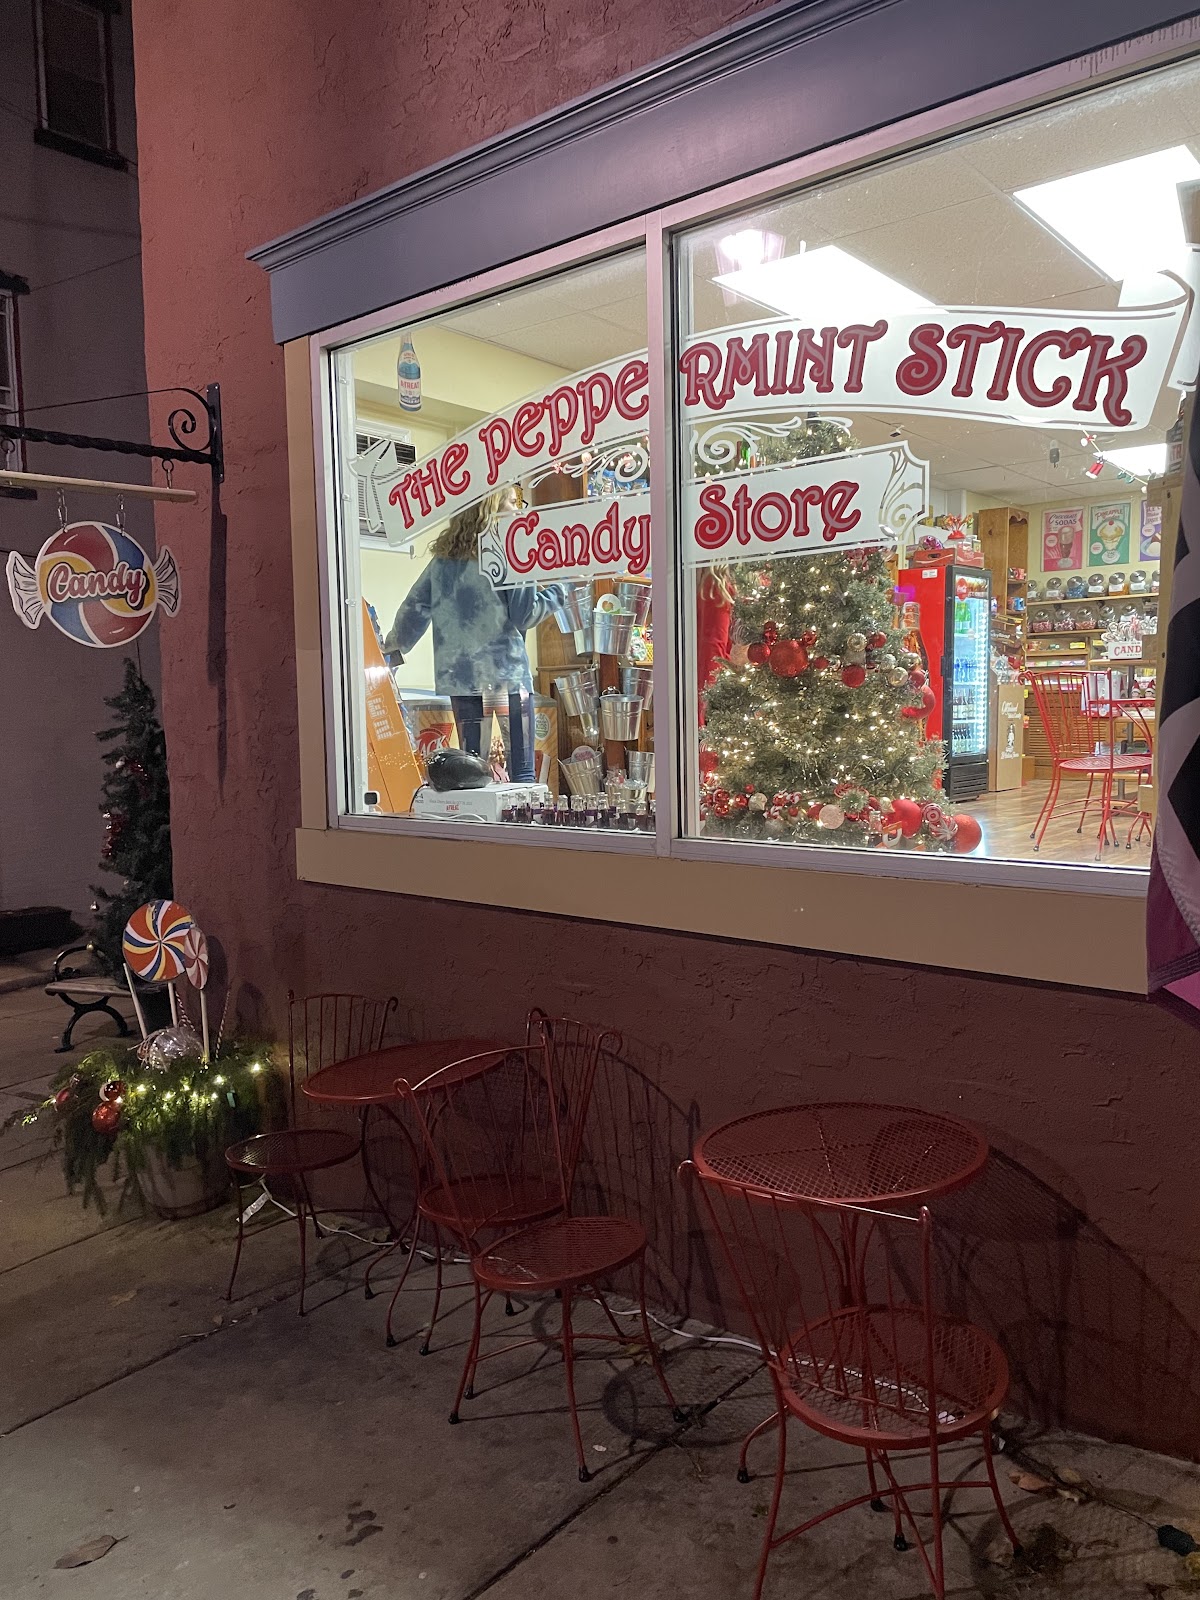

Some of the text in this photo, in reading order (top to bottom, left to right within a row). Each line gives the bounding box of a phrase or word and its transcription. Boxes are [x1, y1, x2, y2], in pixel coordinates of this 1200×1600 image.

[388, 442, 471, 530] THE
[895, 320, 1148, 428] STICK
[505, 480, 862, 575] Candy Store
[1054, 518, 1077, 526] SODAS
[47, 561, 147, 607] Candy
[1113, 645, 1142, 656] CAND
